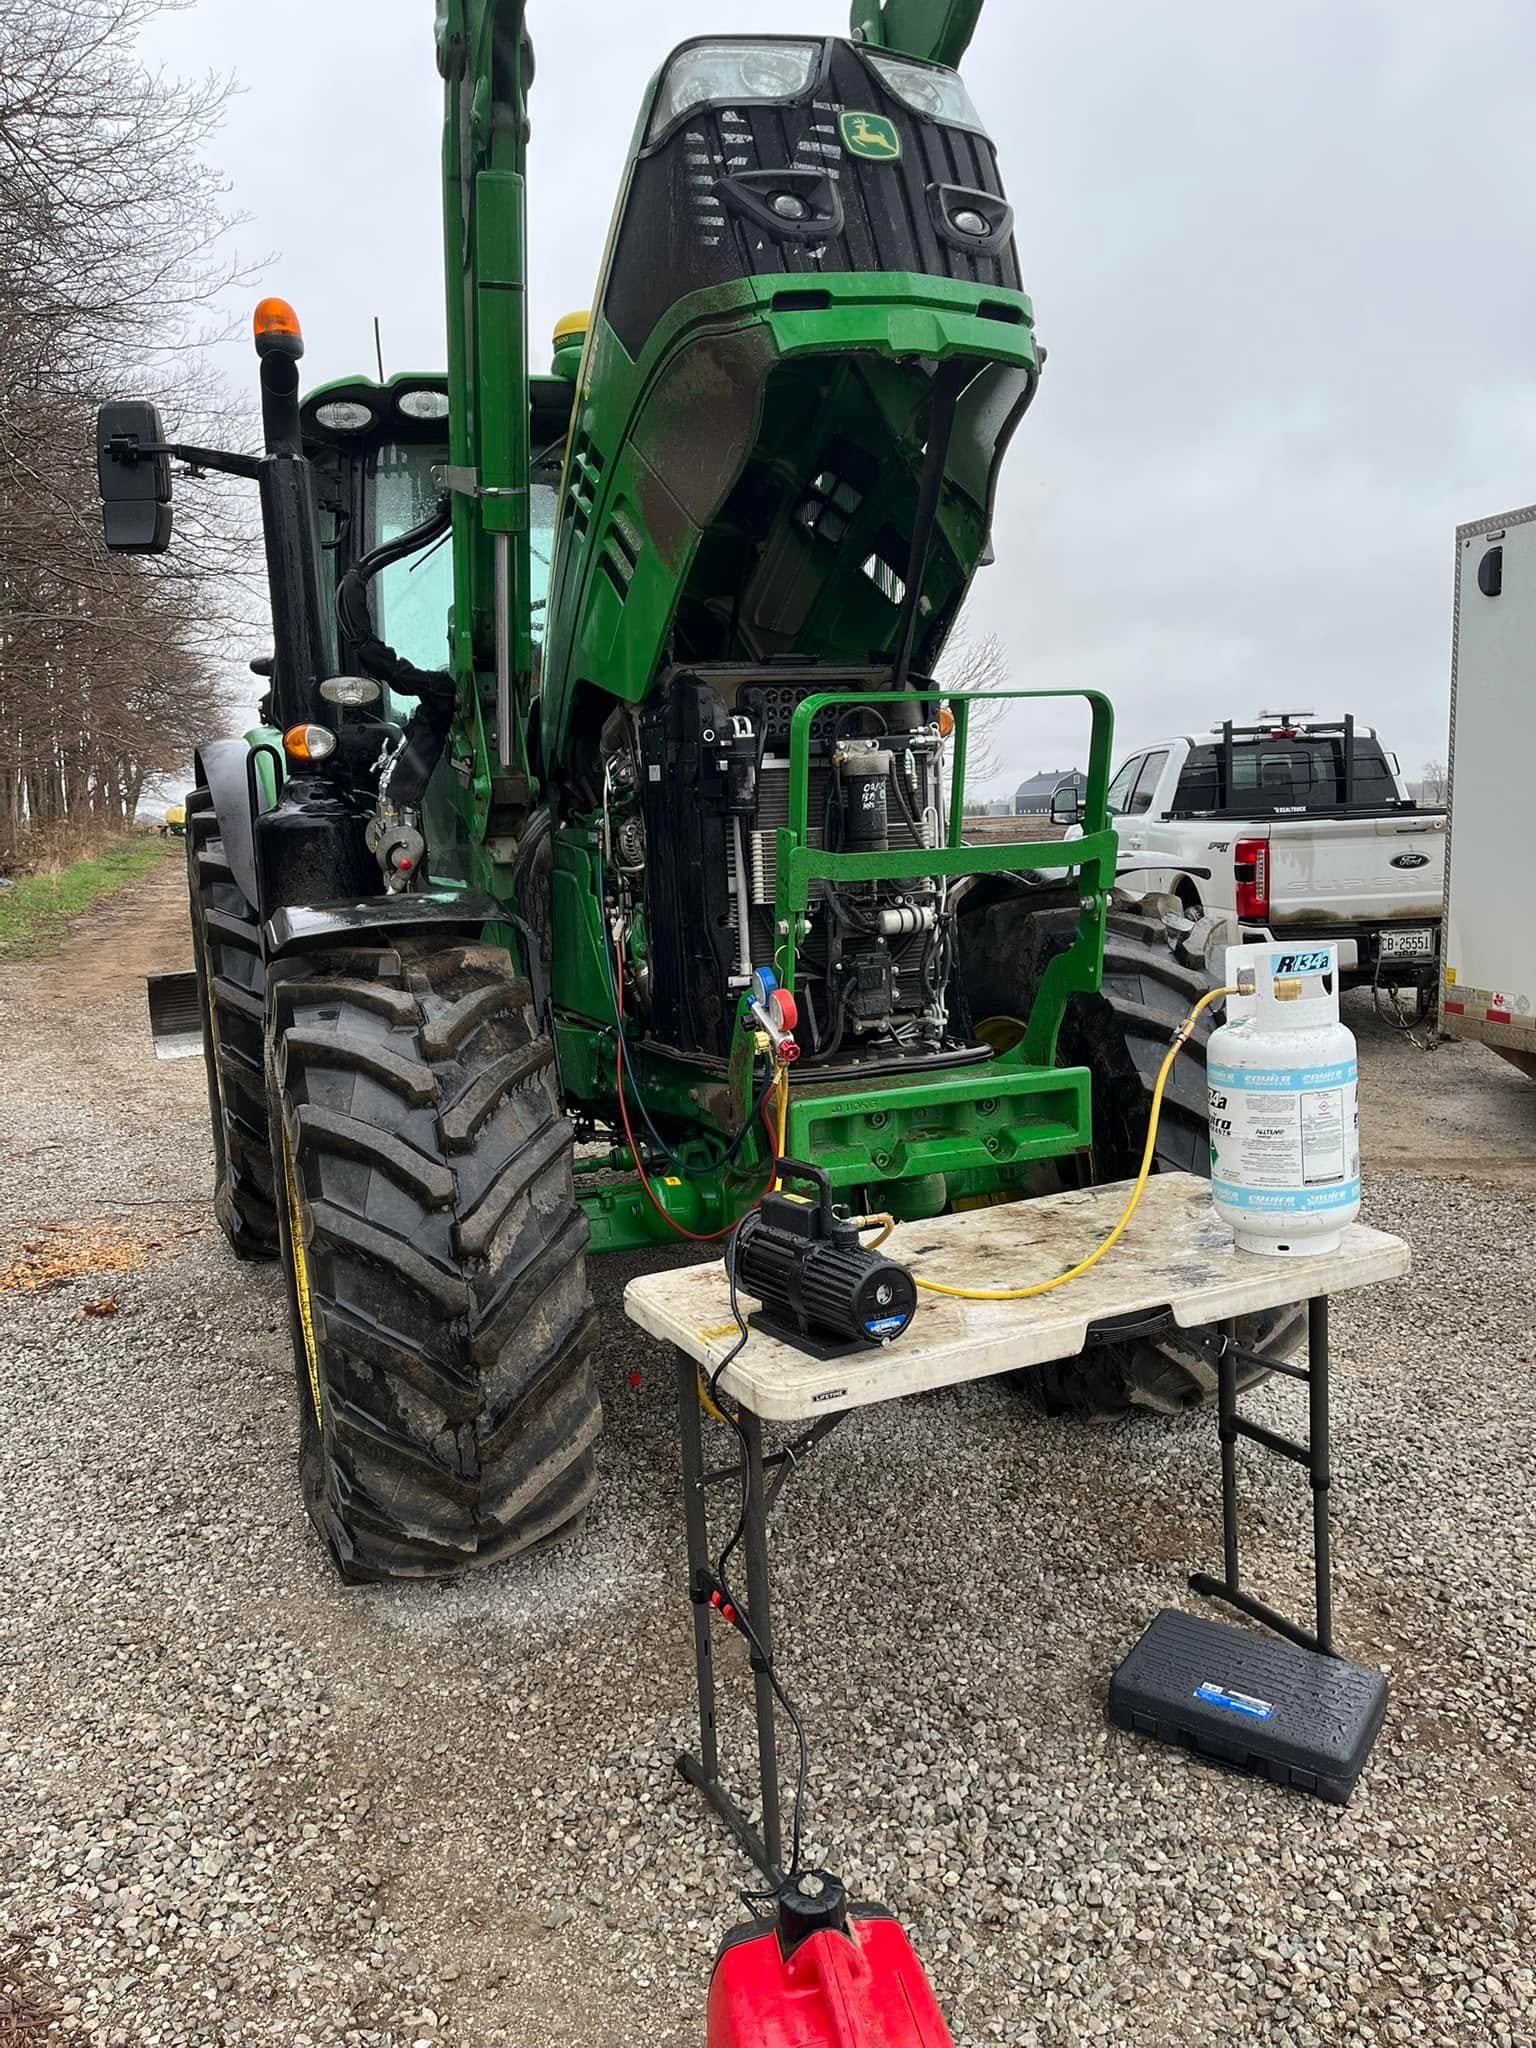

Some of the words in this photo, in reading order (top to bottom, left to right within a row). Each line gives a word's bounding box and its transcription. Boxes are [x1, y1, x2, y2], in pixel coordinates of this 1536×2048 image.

[1287, 874, 1419, 893] SUPER
[1400, 936, 1428, 950] 25551
[1276, 952, 1329, 973] R134a
